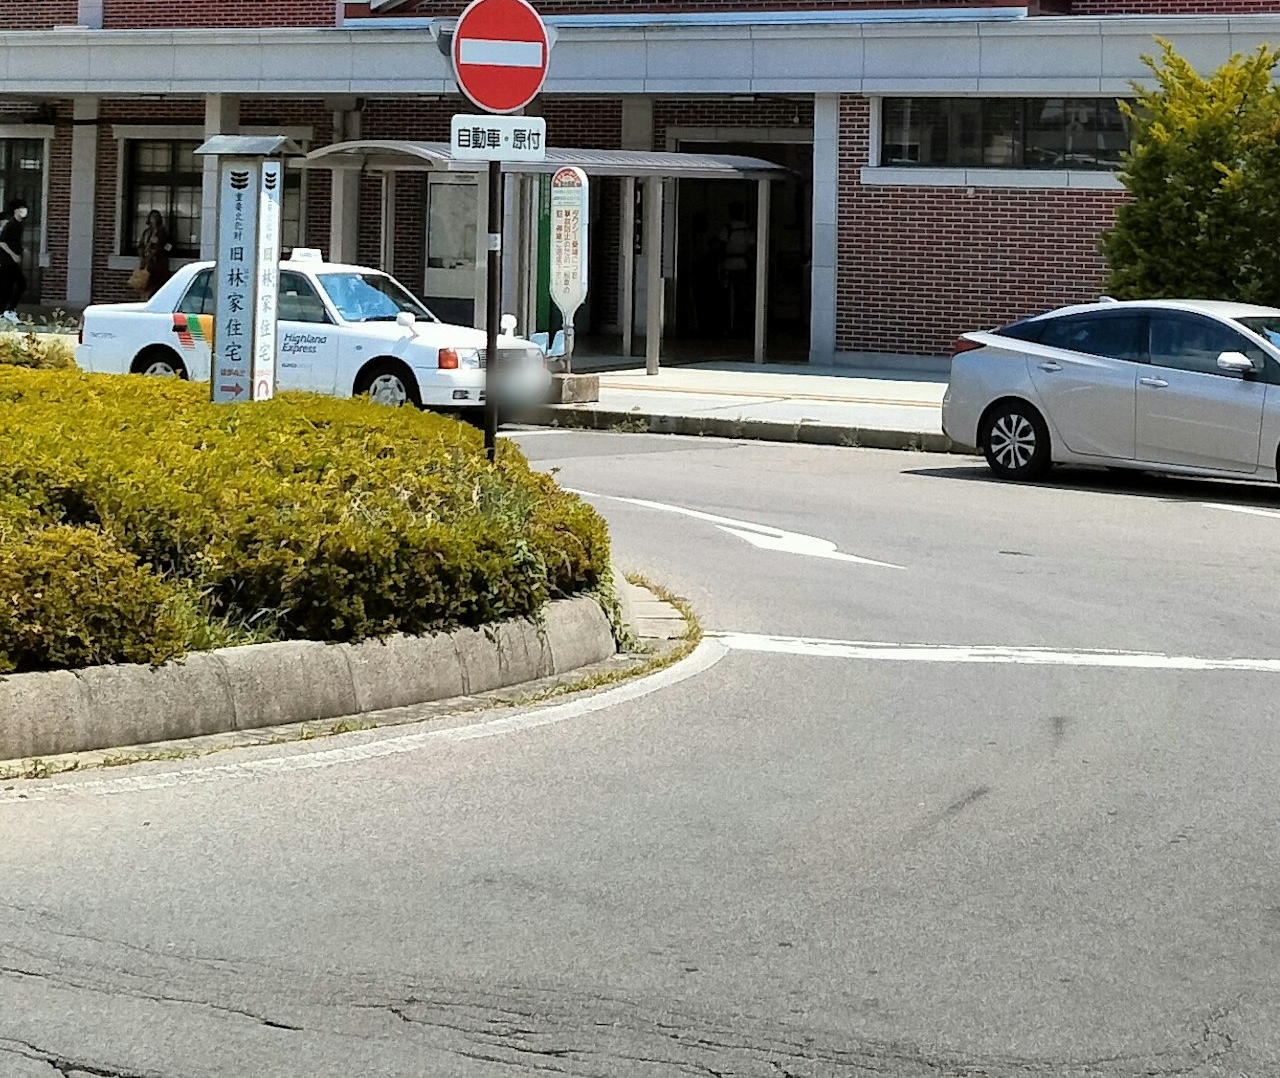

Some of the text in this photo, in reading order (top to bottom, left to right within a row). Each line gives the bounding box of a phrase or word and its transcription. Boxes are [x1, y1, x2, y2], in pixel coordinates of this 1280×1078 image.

[457, 126, 542, 150] 自動車・原付
[283, 332, 327, 345] Highland
[281, 342, 317, 355] Express
